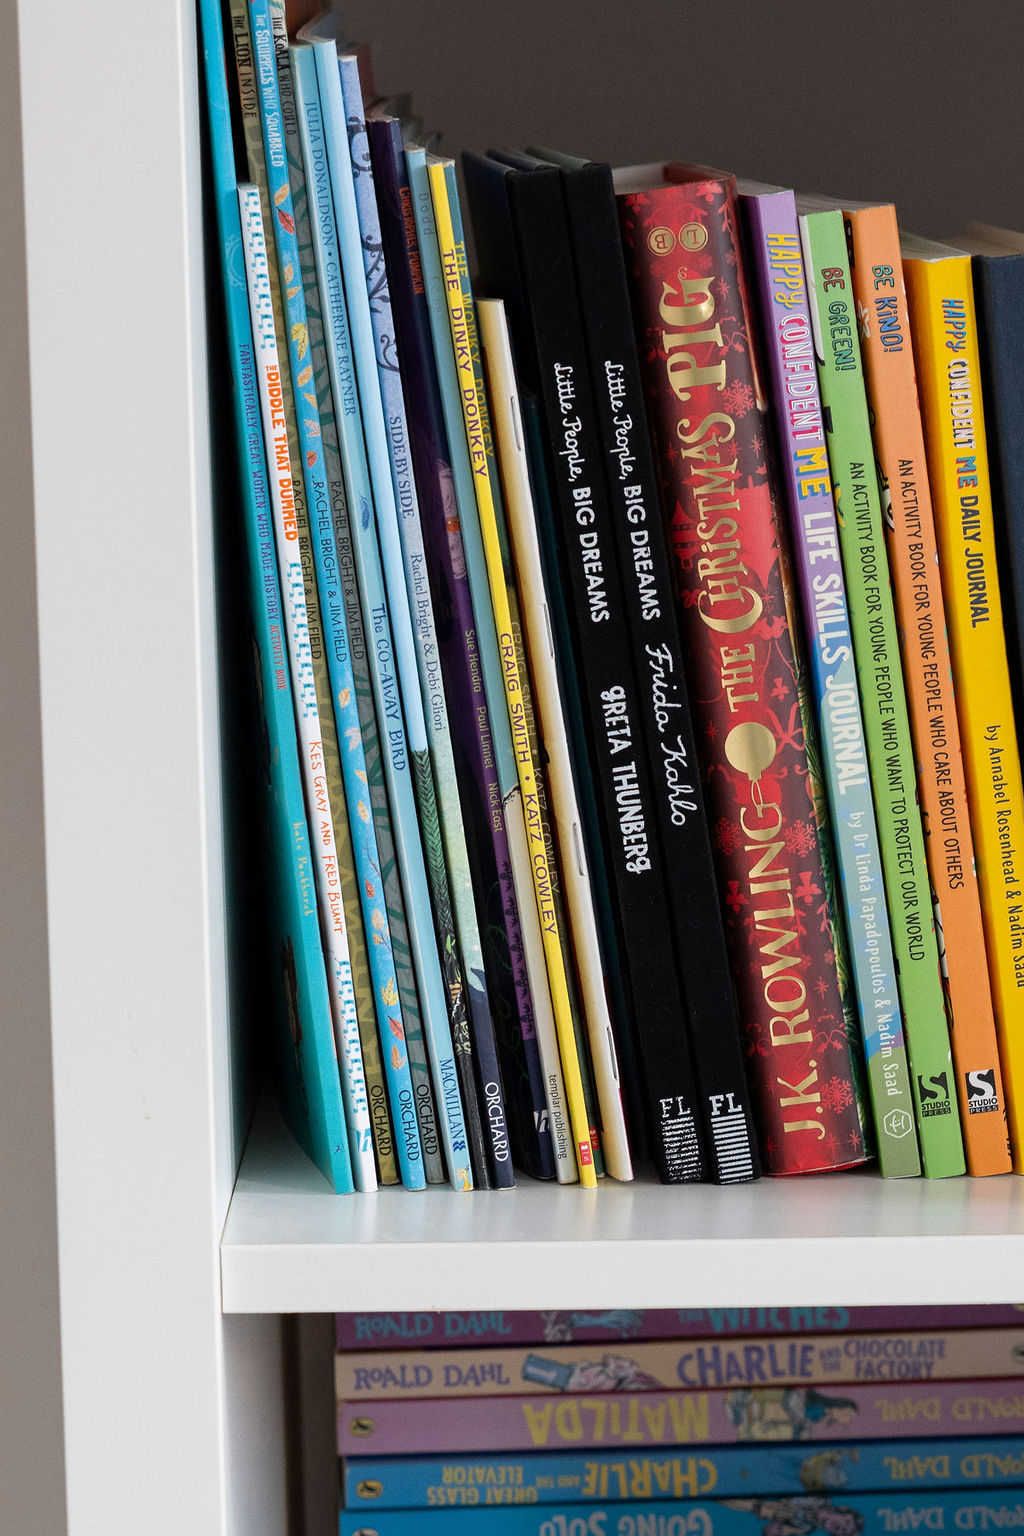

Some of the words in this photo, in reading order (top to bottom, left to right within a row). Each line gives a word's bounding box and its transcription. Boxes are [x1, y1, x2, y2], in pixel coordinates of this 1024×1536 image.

[303, 102, 321, 143] JULIA
[310, 148, 334, 246] DONALDSON
[821, 267, 845, 292] BE
[325, 263, 348, 358] CATHERINE
[828, 301, 855, 370] GREEN!
[442, 249, 458, 291] THE
[451, 307, 472, 372] DINKY
[463, 387, 488, 477] DONKEY
[658, 276, 729, 402] PIG
[337, 357, 355, 415] RAYNER
[554, 360, 578, 414] Little
[778, 312, 823, 443] CONFIDENT
[554, 415, 589, 482] People,
[794, 446, 831, 499] ME
[898, 459, 913, 476] AN
[572, 486, 595, 526] BIG
[901, 481, 921, 537] ACTIVITY
[803, 511, 838, 564] LIFE
[908, 542, 925, 580] BOOK
[579, 531, 610, 623] DREAMS
[913, 584, 930, 611] FOR
[811, 572, 850, 663] SKILLS
[917, 614, 935, 658] YOUNG
[375, 638, 399, 721] GO-AWAY
[389, 729, 405, 770] BIRD
[645, 643, 680, 731] Frida
[722, 642, 760, 714] THE
[923, 663, 942, 711] PEOPLE
[823, 672, 864, 793] JOURNAL
[929, 715, 946, 747] WHO
[983, 725, 1000, 740] by
[660, 735, 696, 825] Kahlo
[934, 752, 951, 785] CARE
[989, 747, 1009, 803] Annabel
[938, 791, 957, 832] ABOUT
[944, 838, 963, 889] OTHERS
[996, 809, 1018, 883] Rosenhead
[1005, 890, 1021, 899] &
[740, 803, 813, 1048] ROWLING
[1008, 904, 1024, 949] Nadim
[548, 1074, 560, 1107] templar
[780, 1060, 826, 1142] J.K.
[551, 1110, 567, 1159] publishing
[676, 1344, 815, 1388] CHARLIE
[844, 1338, 946, 1360] CHOCOLATE
[855, 1360, 934, 1380] FACTORY
[354, 1365, 432, 1390] ROALD
[443, 1363, 511, 1388] DAHL
